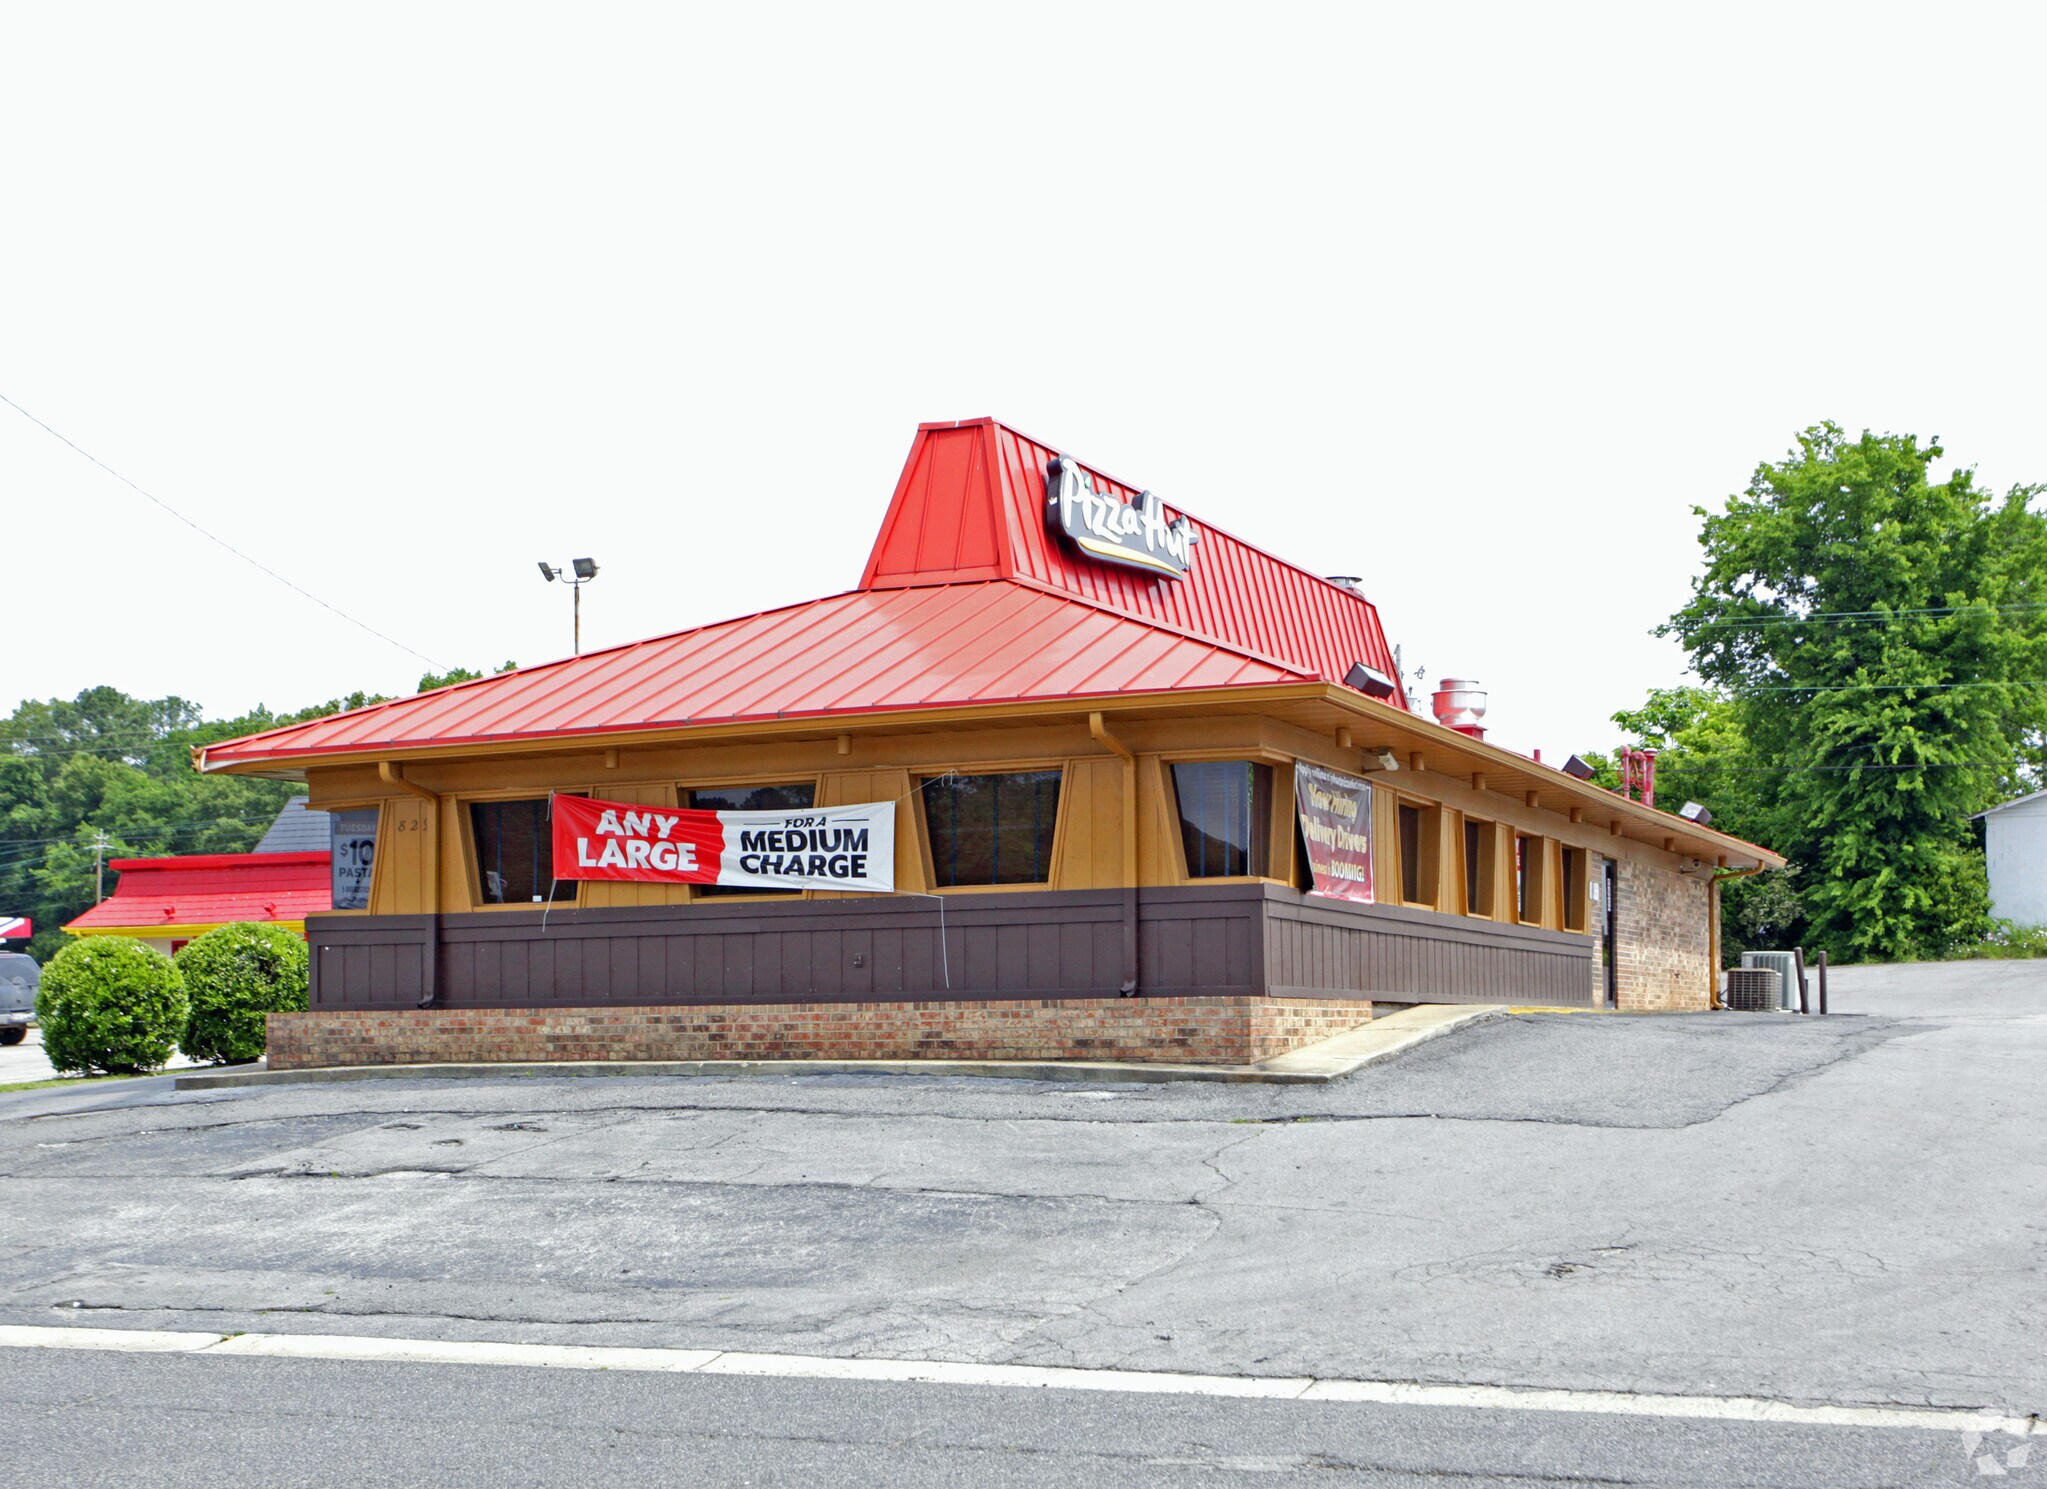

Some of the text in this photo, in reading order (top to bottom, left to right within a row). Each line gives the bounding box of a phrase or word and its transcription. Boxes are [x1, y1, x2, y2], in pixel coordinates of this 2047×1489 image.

[1062, 458, 1198, 567] Pizza Hut
[1308, 783, 1357, 824] Now Hiring
[595, 809, 680, 838] ANY
[784, 816, 827, 829] FOR A
[1300, 814, 1367, 854] Delivery Drivers
[340, 839, 375, 866] $10
[577, 837, 699, 872] LARGE
[740, 828, 869, 853] MEDIUM
[739, 853, 868, 879] CHARGE
